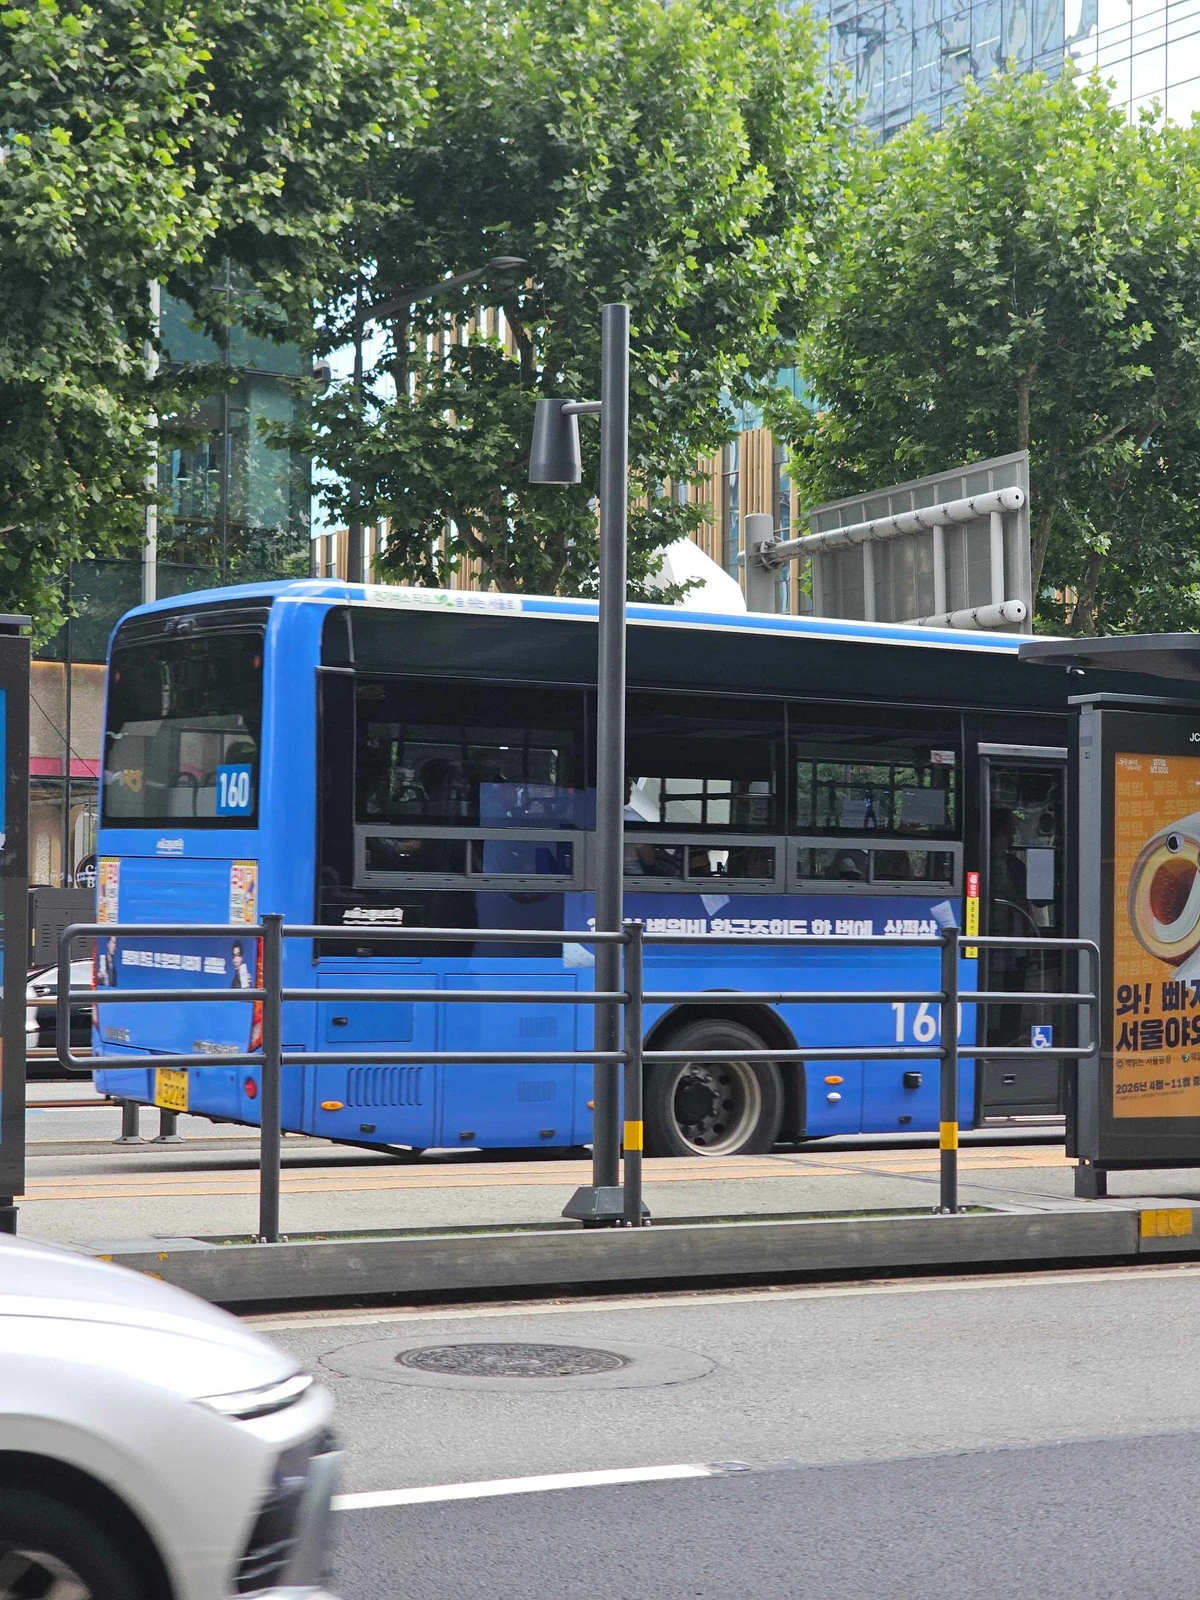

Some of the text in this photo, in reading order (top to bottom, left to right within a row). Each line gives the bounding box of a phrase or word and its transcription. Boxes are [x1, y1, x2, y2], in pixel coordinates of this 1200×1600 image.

[220, 771, 250, 808] 160
[1116, 983, 1152, 1016] 와!
[1116, 1082, 1147, 1095] 2026년
